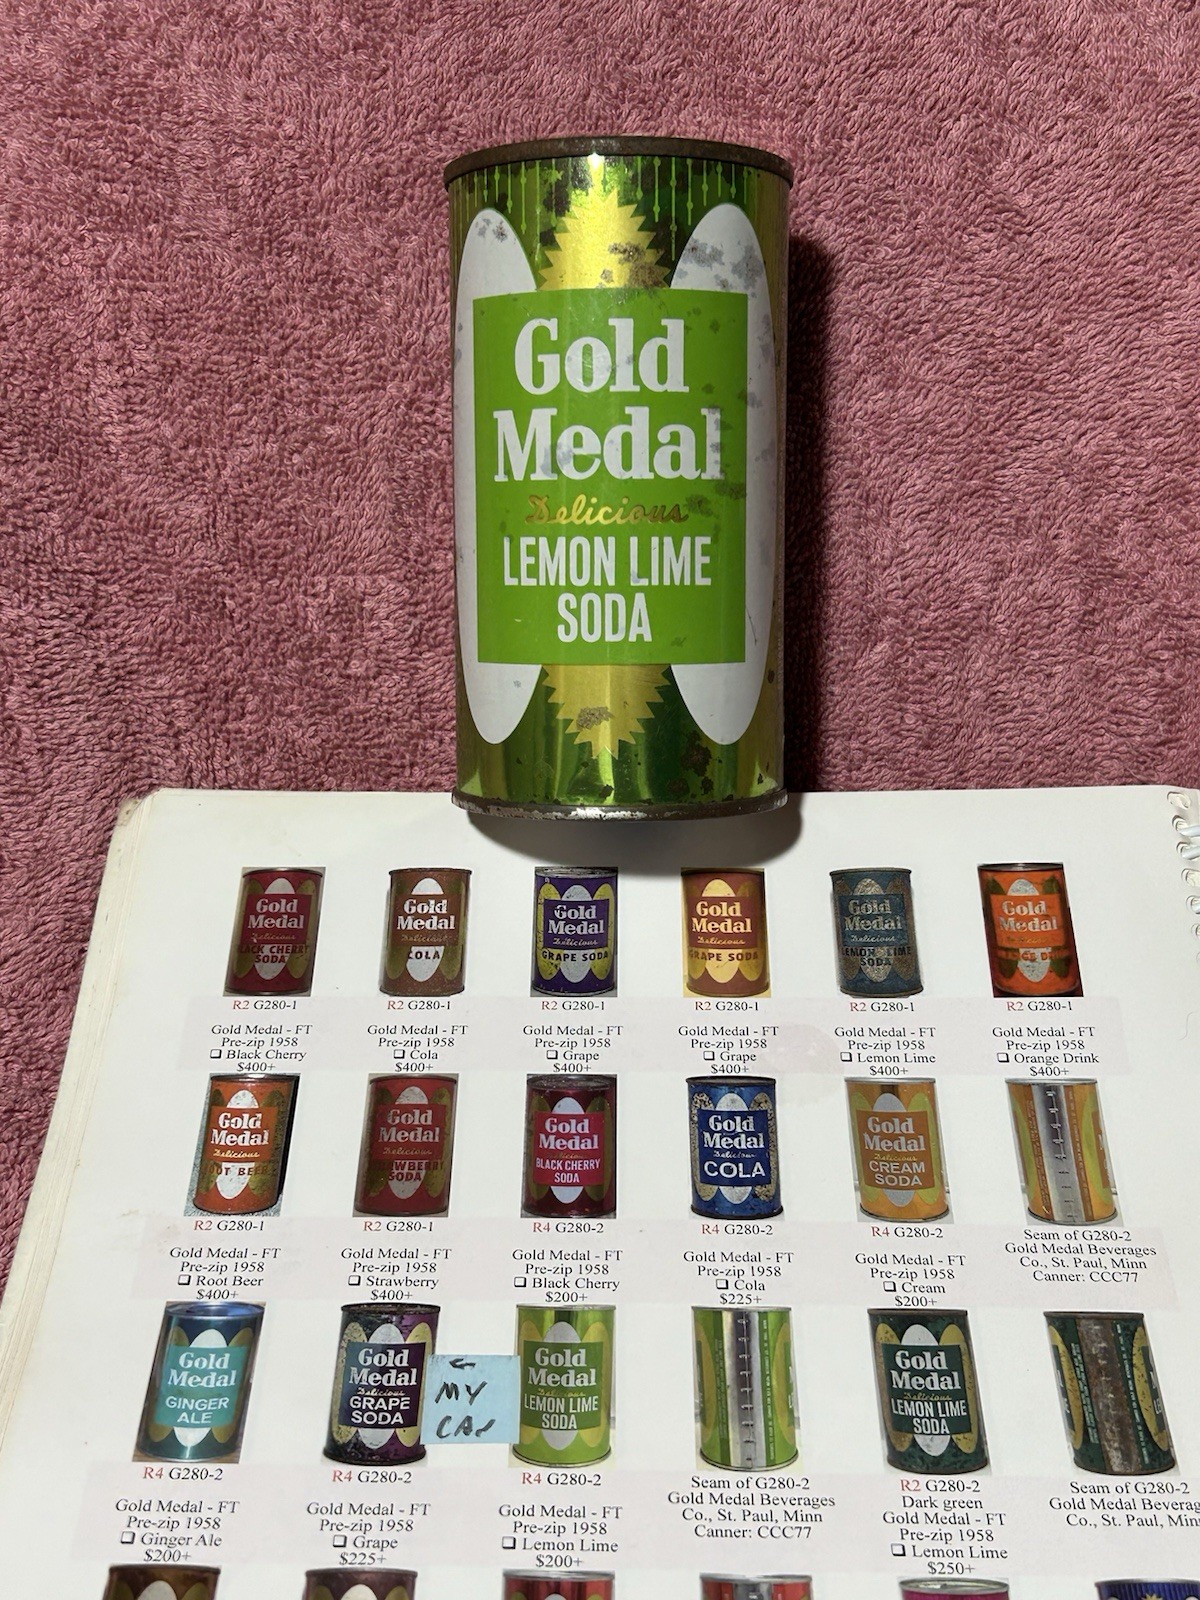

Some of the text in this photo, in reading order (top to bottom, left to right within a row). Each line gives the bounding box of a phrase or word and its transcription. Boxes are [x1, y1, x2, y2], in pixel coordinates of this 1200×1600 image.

[514, 317, 690, 395] Gold
[493, 406, 725, 482] Medal
[525, 494, 690, 526] Delicious
[503, 536, 712, 587] LEMON LIME
[557, 592, 652, 643] SODA
[696, 900, 742, 917] Gold
[692, 917, 752, 934] Medal
[233, 1000, 296, 1010] R2 G280-1
[387, 1000, 450, 1010] R2 G280-1
[542, 1000, 604, 1010] R2 G280-1
[695, 1001, 758, 1011] R2 G280-1
[850, 1002, 914, 1012] R2 G280-1
[1006, 1000, 1072, 1011] R2 G280-1
[211, 1024, 242, 1035] Gold
[244, 1024, 283, 1034] Medal
[295, 1024, 313, 1034] FT
[221, 1037, 298, 1050] Pre-zip 1958
[226, 1049, 307, 1062] Black Cherry
[410, 1050, 438, 1060] Cola
[563, 1050, 600, 1063] Grape
[720, 1051, 756, 1064] Grape
[857, 1052, 936, 1063] Lemon Lime
[1014, 1053, 1099, 1066] Orange Drink
[236, 1062, 276, 1072] $400+
[394, 1062, 434, 1072] $400+
[553, 1062, 592, 1073] $400+
[710, 1064, 749, 1074] $400+
[869, 1065, 908, 1076] $400+
[1030, 1064, 1069, 1076] $400+
[708, 1115, 755, 1133] Gold
[867, 1116, 915, 1134] Gold
[703, 1131, 765, 1149] Medal
[863, 1132, 926, 1152] Medal
[703, 1160, 766, 1178] COLA
[868, 1161, 925, 1174] CREAM
[874, 1174, 922, 1186] SODA
[194, 1220, 264, 1231] R2 G280-1
[363, 1221, 433, 1232] R2 G280-1
[533, 1222, 604, 1234] R4 G280-2
[702, 1224, 773, 1236] R4 G280-2
[871, 1226, 943, 1238] R4 G280-2
[1024, 1229, 1132, 1242] Seam of G280-2
[1005, 1242, 1156, 1258] Gold Medal Beverages
[1020, 1256, 1147, 1270] Co., St. Paul, Minn
[196, 1275, 264, 1286] Root Beer
[366, 1275, 439, 1290] Strawberry
[1033, 1270, 1138, 1282] Canner: CCC77
[532, 1277, 620, 1292] Black Cherry
[734, 1278, 766, 1291] Cola
[901, 1282, 946, 1294] Cream
[196, 1288, 239, 1300] $400+
[370, 1289, 413, 1301] $400+
[545, 1291, 588, 1303] $200+
[720, 1293, 762, 1305] $225+
[894, 1295, 938, 1307] $200+
[179, 1352, 231, 1370] Gold
[358, 1348, 409, 1367] Gold
[535, 1348, 587, 1367] Gold
[895, 1350, 948, 1370] Gold
[168, 1369, 237, 1388] Medal
[348, 1367, 417, 1387] Medal
[528, 1367, 596, 1387] Medal
[890, 1370, 962, 1391] Medal
[435, 1381, 488, 1406] MY
[165, 1396, 230, 1411] GINGER
[349, 1396, 410, 1410] GRAPE
[524, 1393, 599, 1413] LEMON LIME
[890, 1398, 967, 1418] LEMON LIME
[176, 1412, 213, 1424] ALE
[350, 1410, 404, 1425] SODA
[541, 1413, 577, 1430] SODA
[913, 1418, 950, 1434] SODA
[143, 1467, 223, 1481] R4 G280-2
[332, 1470, 412, 1484] R4 G280-2
[522, 1472, 601, 1486] R4 G280-2
[691, 1476, 810, 1490] Seam of G280-2
[900, 1479, 980, 1493] R2 G280-2
[1070, 1481, 1190, 1494] Seam of G280-2
[668, 1491, 836, 1510] Gold Medal Beverages
[902, 1495, 983, 1512] Dark green
[1049, 1497, 1086, 1510] Gold
[1090, 1498, 1137, 1511] Medal
[682, 1508, 822, 1524] Co., St. Paul, Minn
[882, 1511, 920, 1525] Gold
[924, 1512, 971, 1525] Medal
[986, 1513, 1006, 1526] FT
[1066, 1514, 1200, 1529] Co., St. Paul, Min
[694, 1524, 812, 1539] Canner: CCC77
[900, 1528, 994, 1546] Pre-zip 1958
[140, 1532, 222, 1549] Ginger Ale
[352, 1535, 398, 1552] Grape
[522, 1538, 618, 1552] Lemon Lime
[143, 1548, 191, 1562] $200+
[339, 1552, 386, 1566] $225+
[912, 1545, 1008, 1559] Lemon Lime
[536, 1554, 582, 1568] $200+
[927, 1561, 975, 1575] $250+
